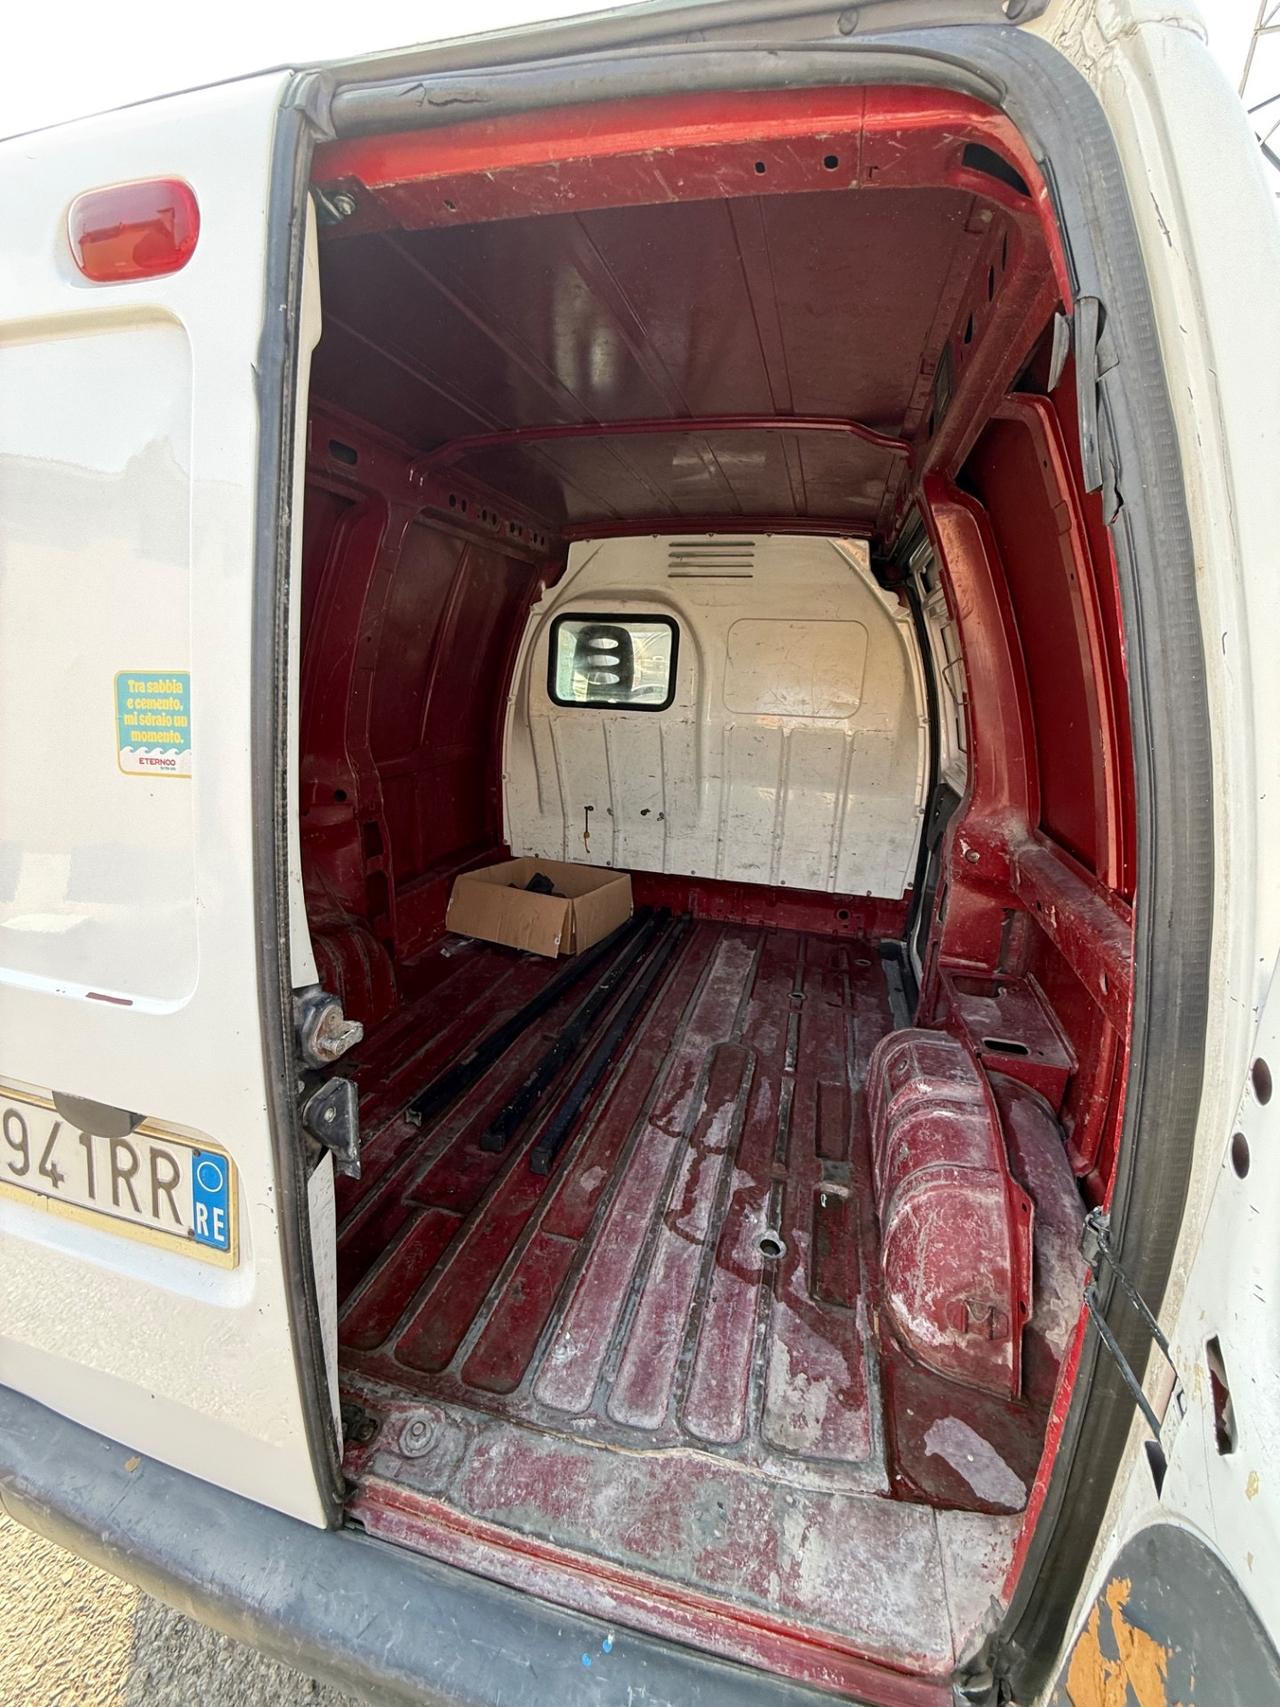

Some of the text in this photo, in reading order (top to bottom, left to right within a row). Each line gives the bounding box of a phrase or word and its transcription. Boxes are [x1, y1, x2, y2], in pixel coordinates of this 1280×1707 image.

[127, 679, 183, 694] Tra sabbia
[127, 697, 183, 711] e cemento,
[124, 711, 138, 726] mi
[174, 714, 188, 727] un
[196, 1202, 225, 1242] RE
